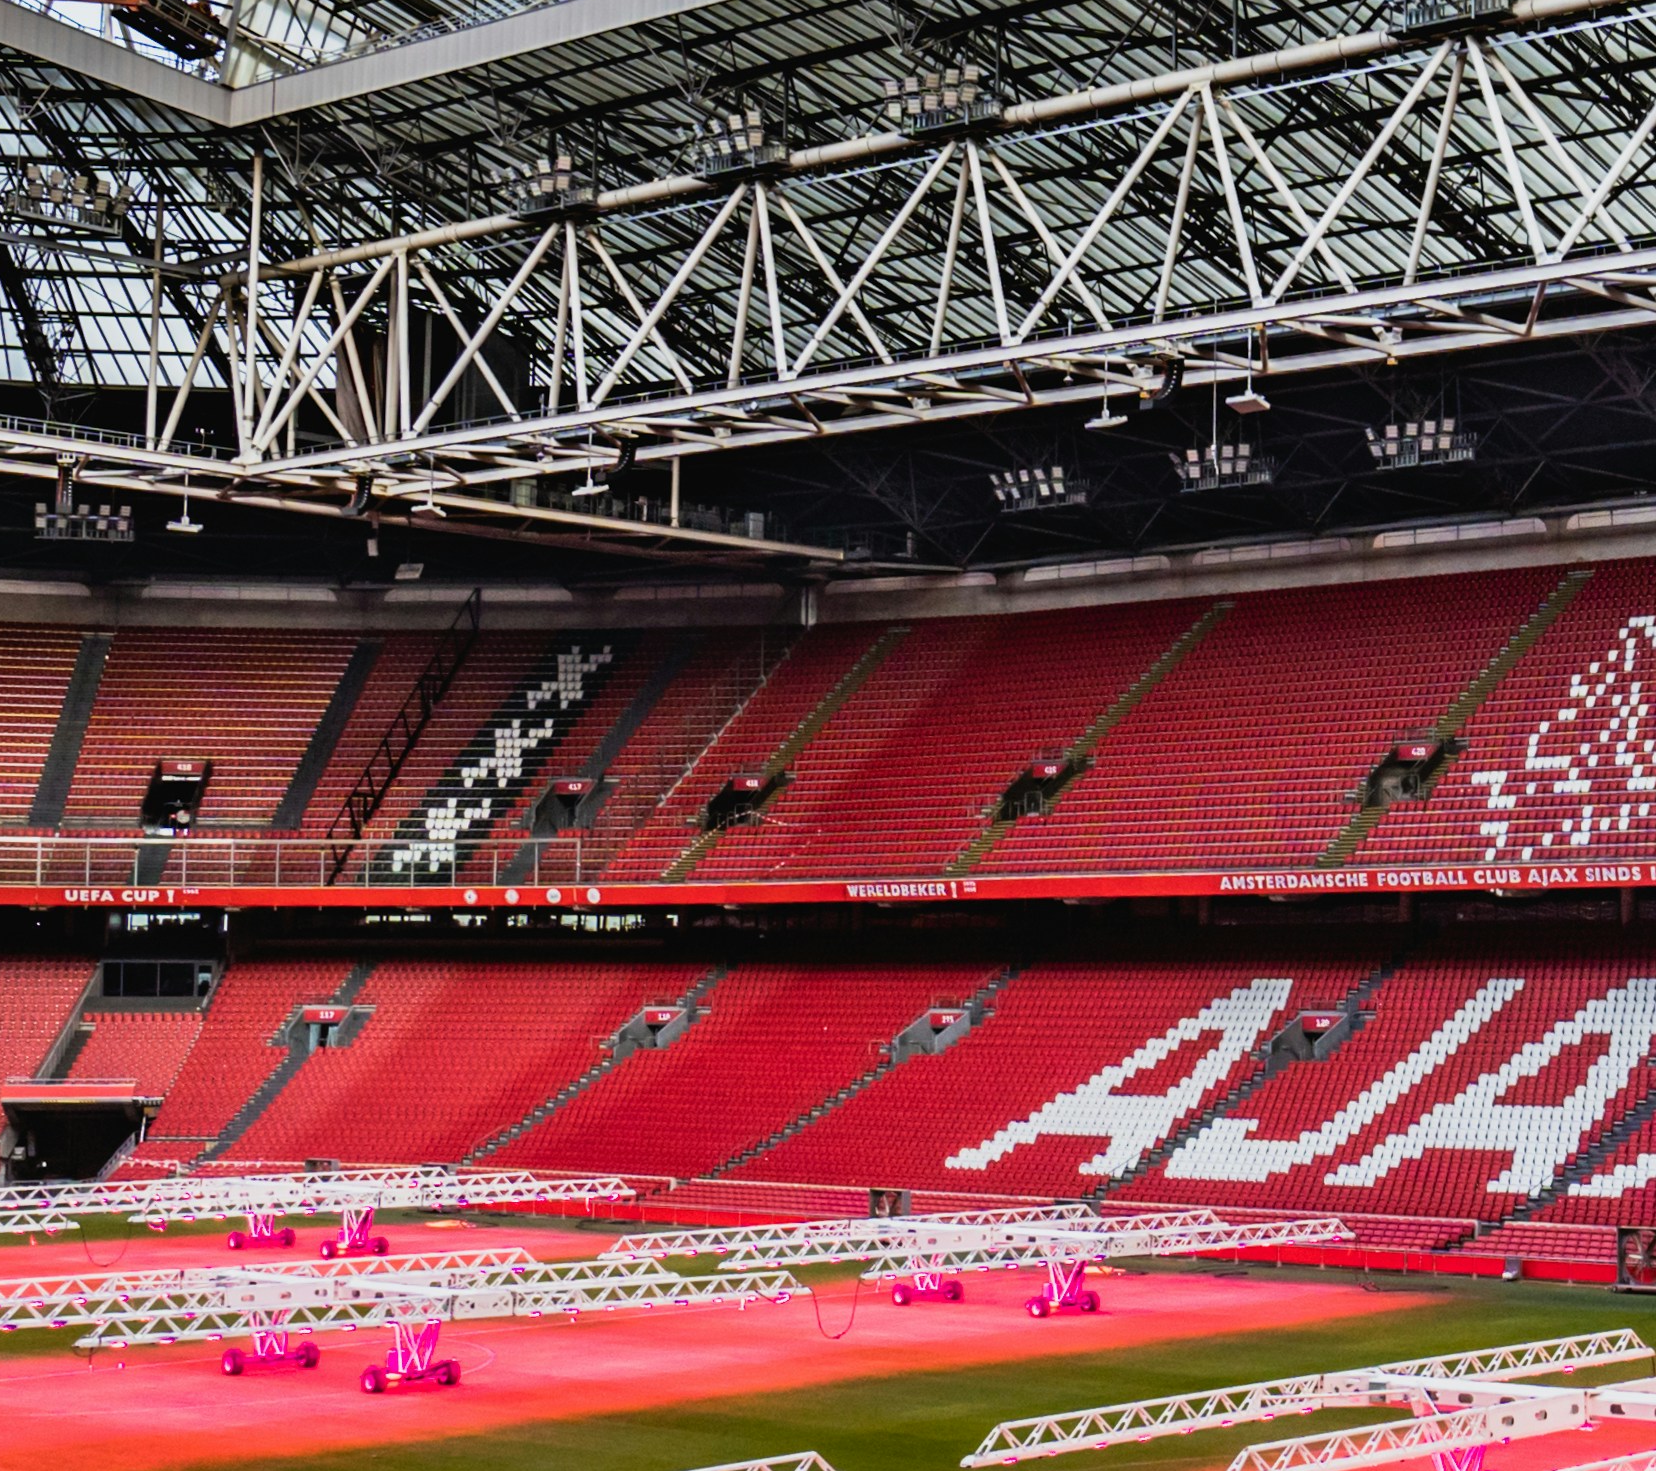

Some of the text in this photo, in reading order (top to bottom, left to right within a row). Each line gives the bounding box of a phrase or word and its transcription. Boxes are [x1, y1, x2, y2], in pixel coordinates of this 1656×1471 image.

[1220, 872, 1369, 890] AMSTERDAMSCHE
[1377, 870, 1468, 887] FOOTBALL
[1473, 869, 1521, 884] CLUB
[1528, 867, 1579, 886] AJAX
[1585, 866, 1642, 882] SINDS
[65, 890, 114, 902] UEFA
[122, 890, 160, 902] CUP
[847, 883, 947, 897] WERELDBEKER
[320, 1011, 335, 1019] 117
